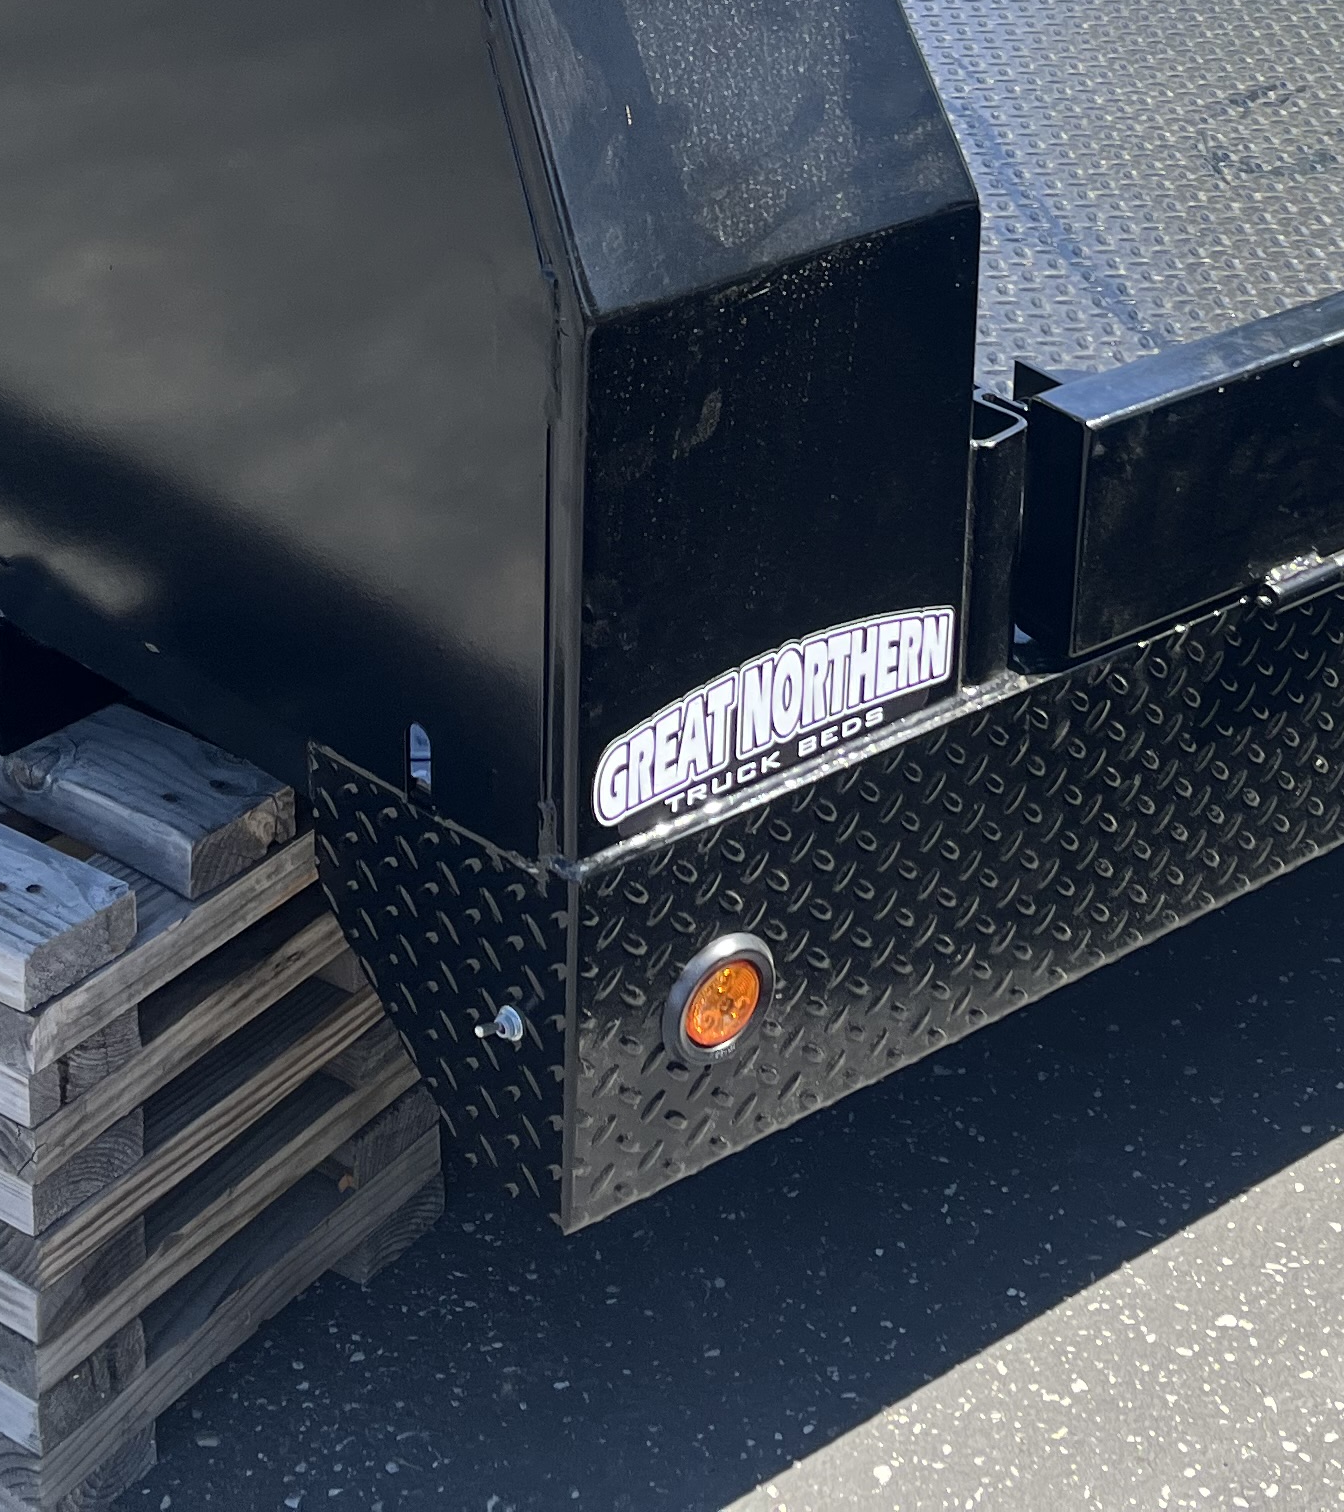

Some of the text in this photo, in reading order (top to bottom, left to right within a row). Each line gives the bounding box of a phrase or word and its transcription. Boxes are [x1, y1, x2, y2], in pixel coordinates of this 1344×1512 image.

[596, 610, 953, 824] GREAT NORTHERN
[664, 706, 884, 813] TRUCK BEDS
